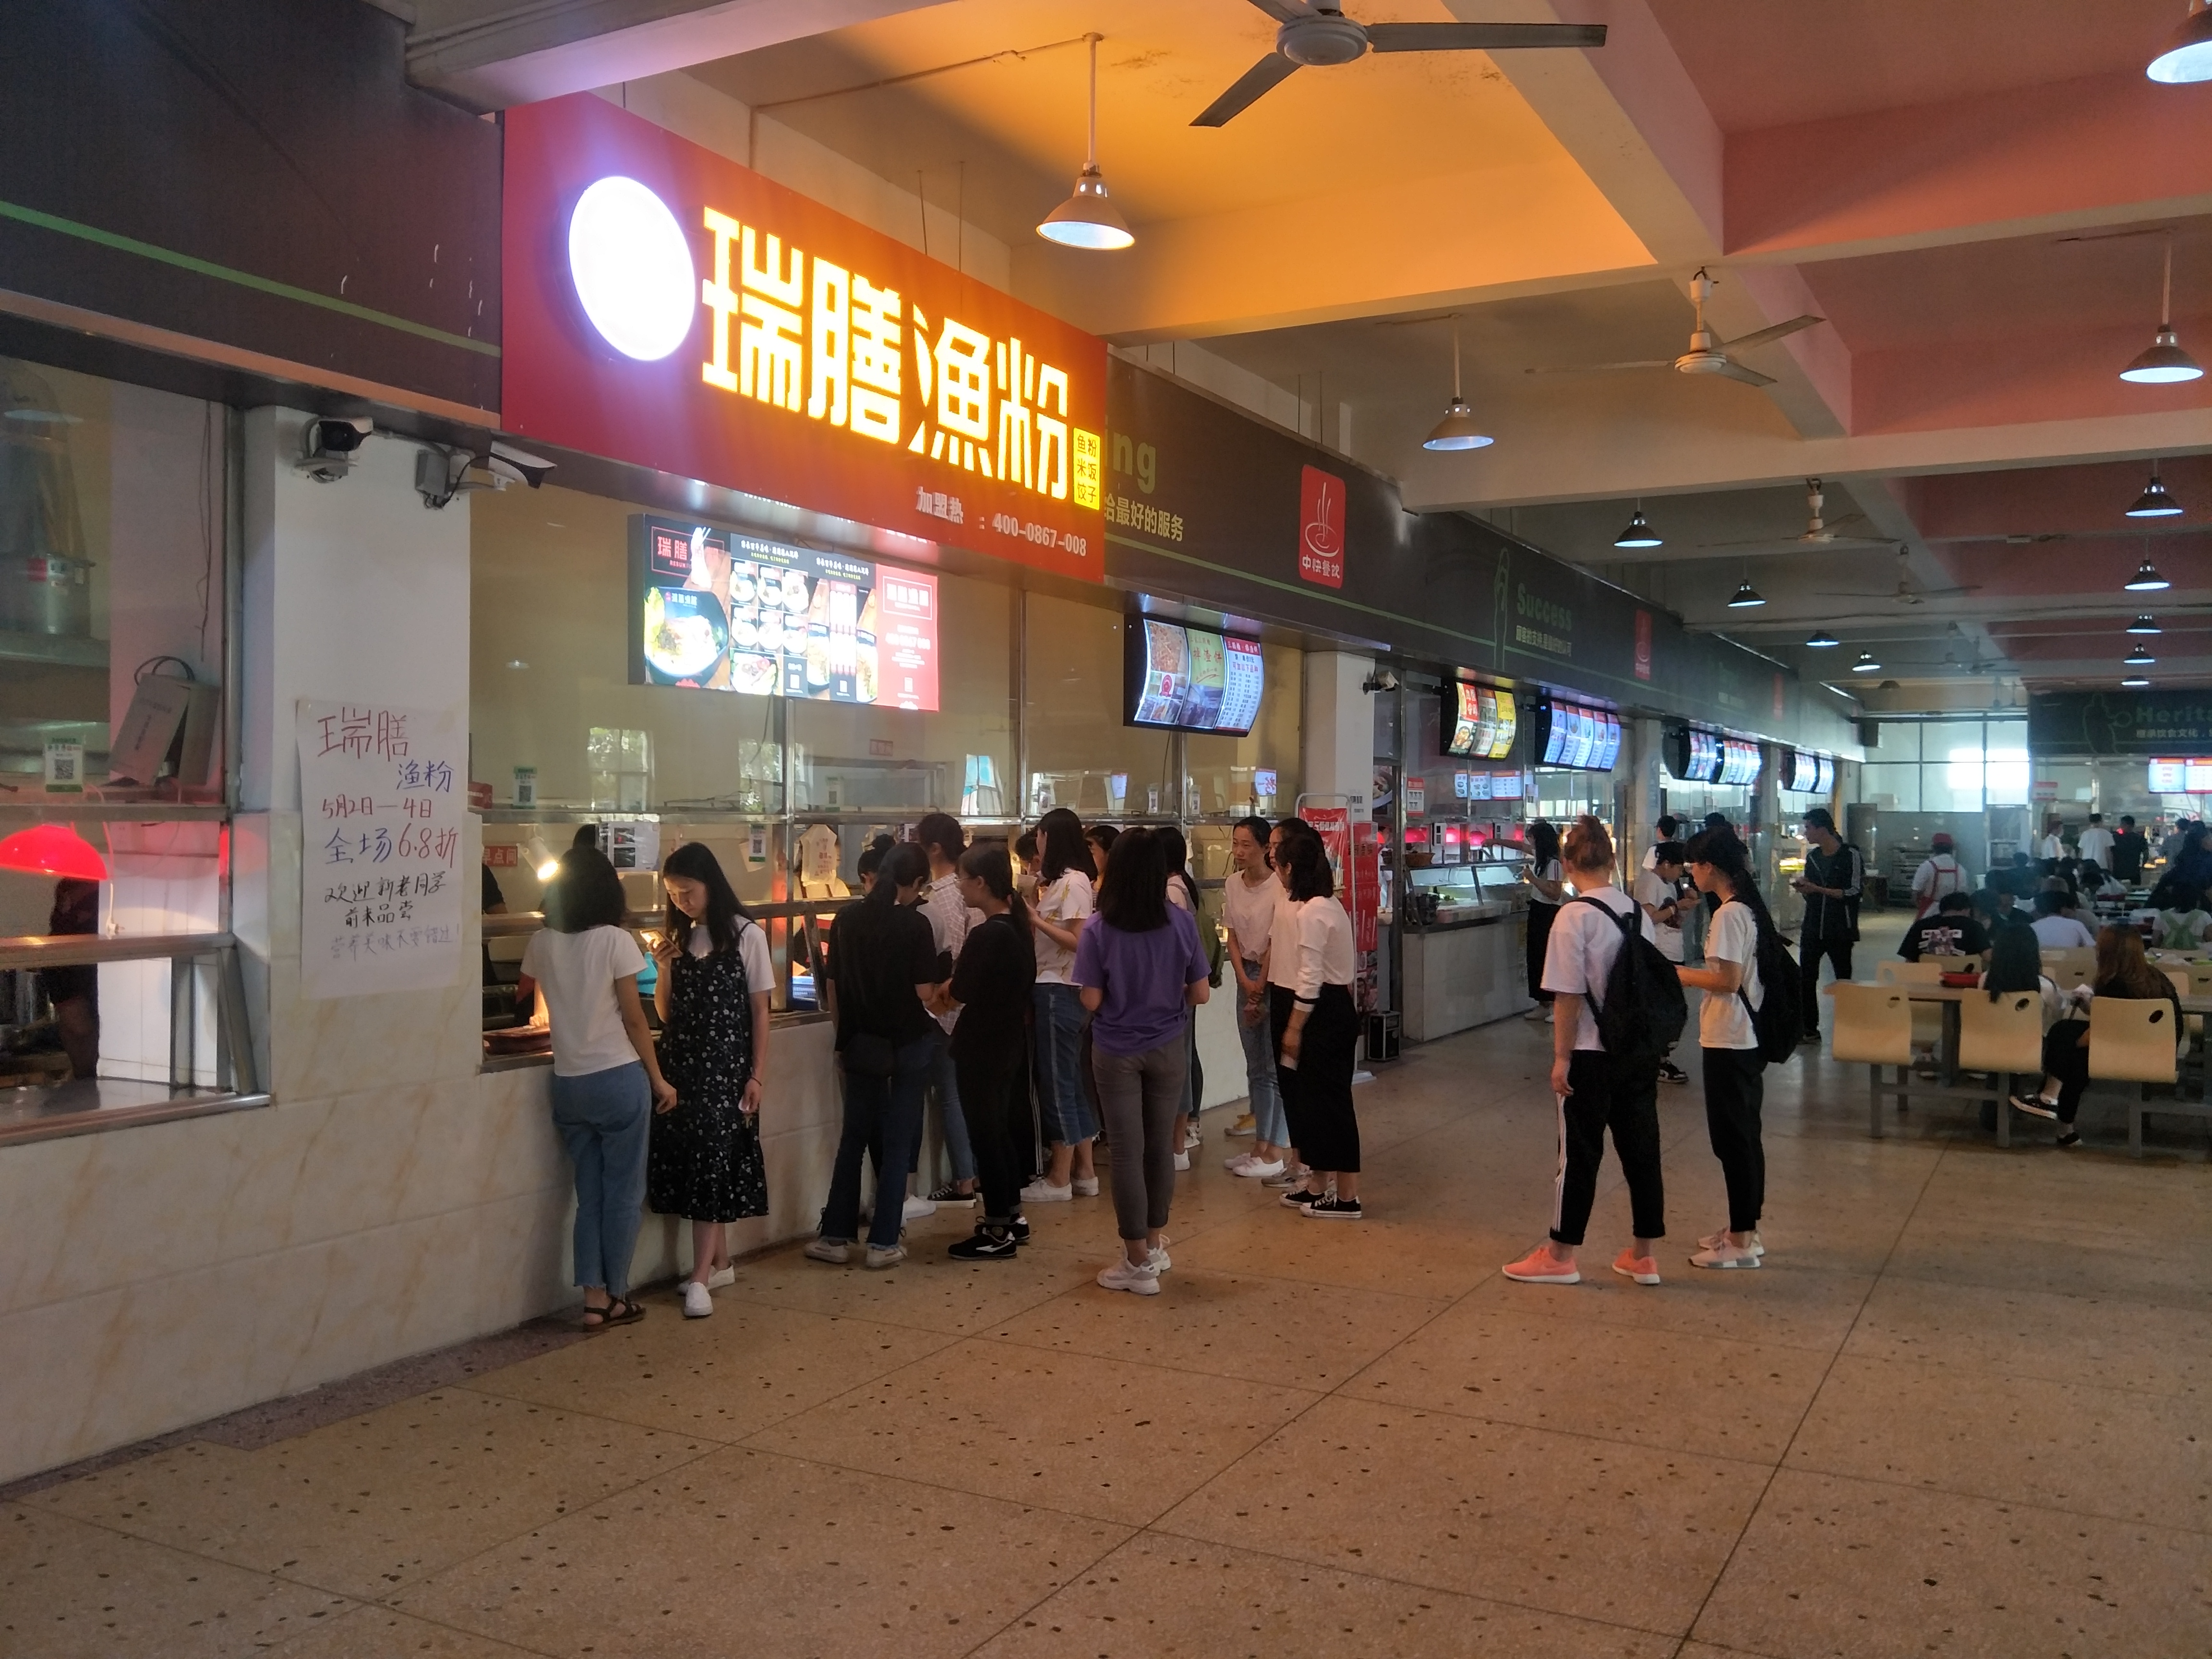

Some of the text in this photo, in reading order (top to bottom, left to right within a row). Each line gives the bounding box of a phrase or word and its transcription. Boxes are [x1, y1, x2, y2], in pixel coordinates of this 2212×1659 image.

[701, 205, 1069, 500] 瑞膳渔粉
[1077, 434, 1097, 457] 鱼粉
[1077, 458, 1097, 481] 米饭
[1077, 481, 1097, 504] 饺子
[1517, 583, 1572, 632] Success
[318, 707, 409, 762] 瑞膳
[396, 759, 454, 793] 渔粉
[325, 871, 447, 903] 欢迎新老同学
[345, 900, 413, 927] 前来品尝
